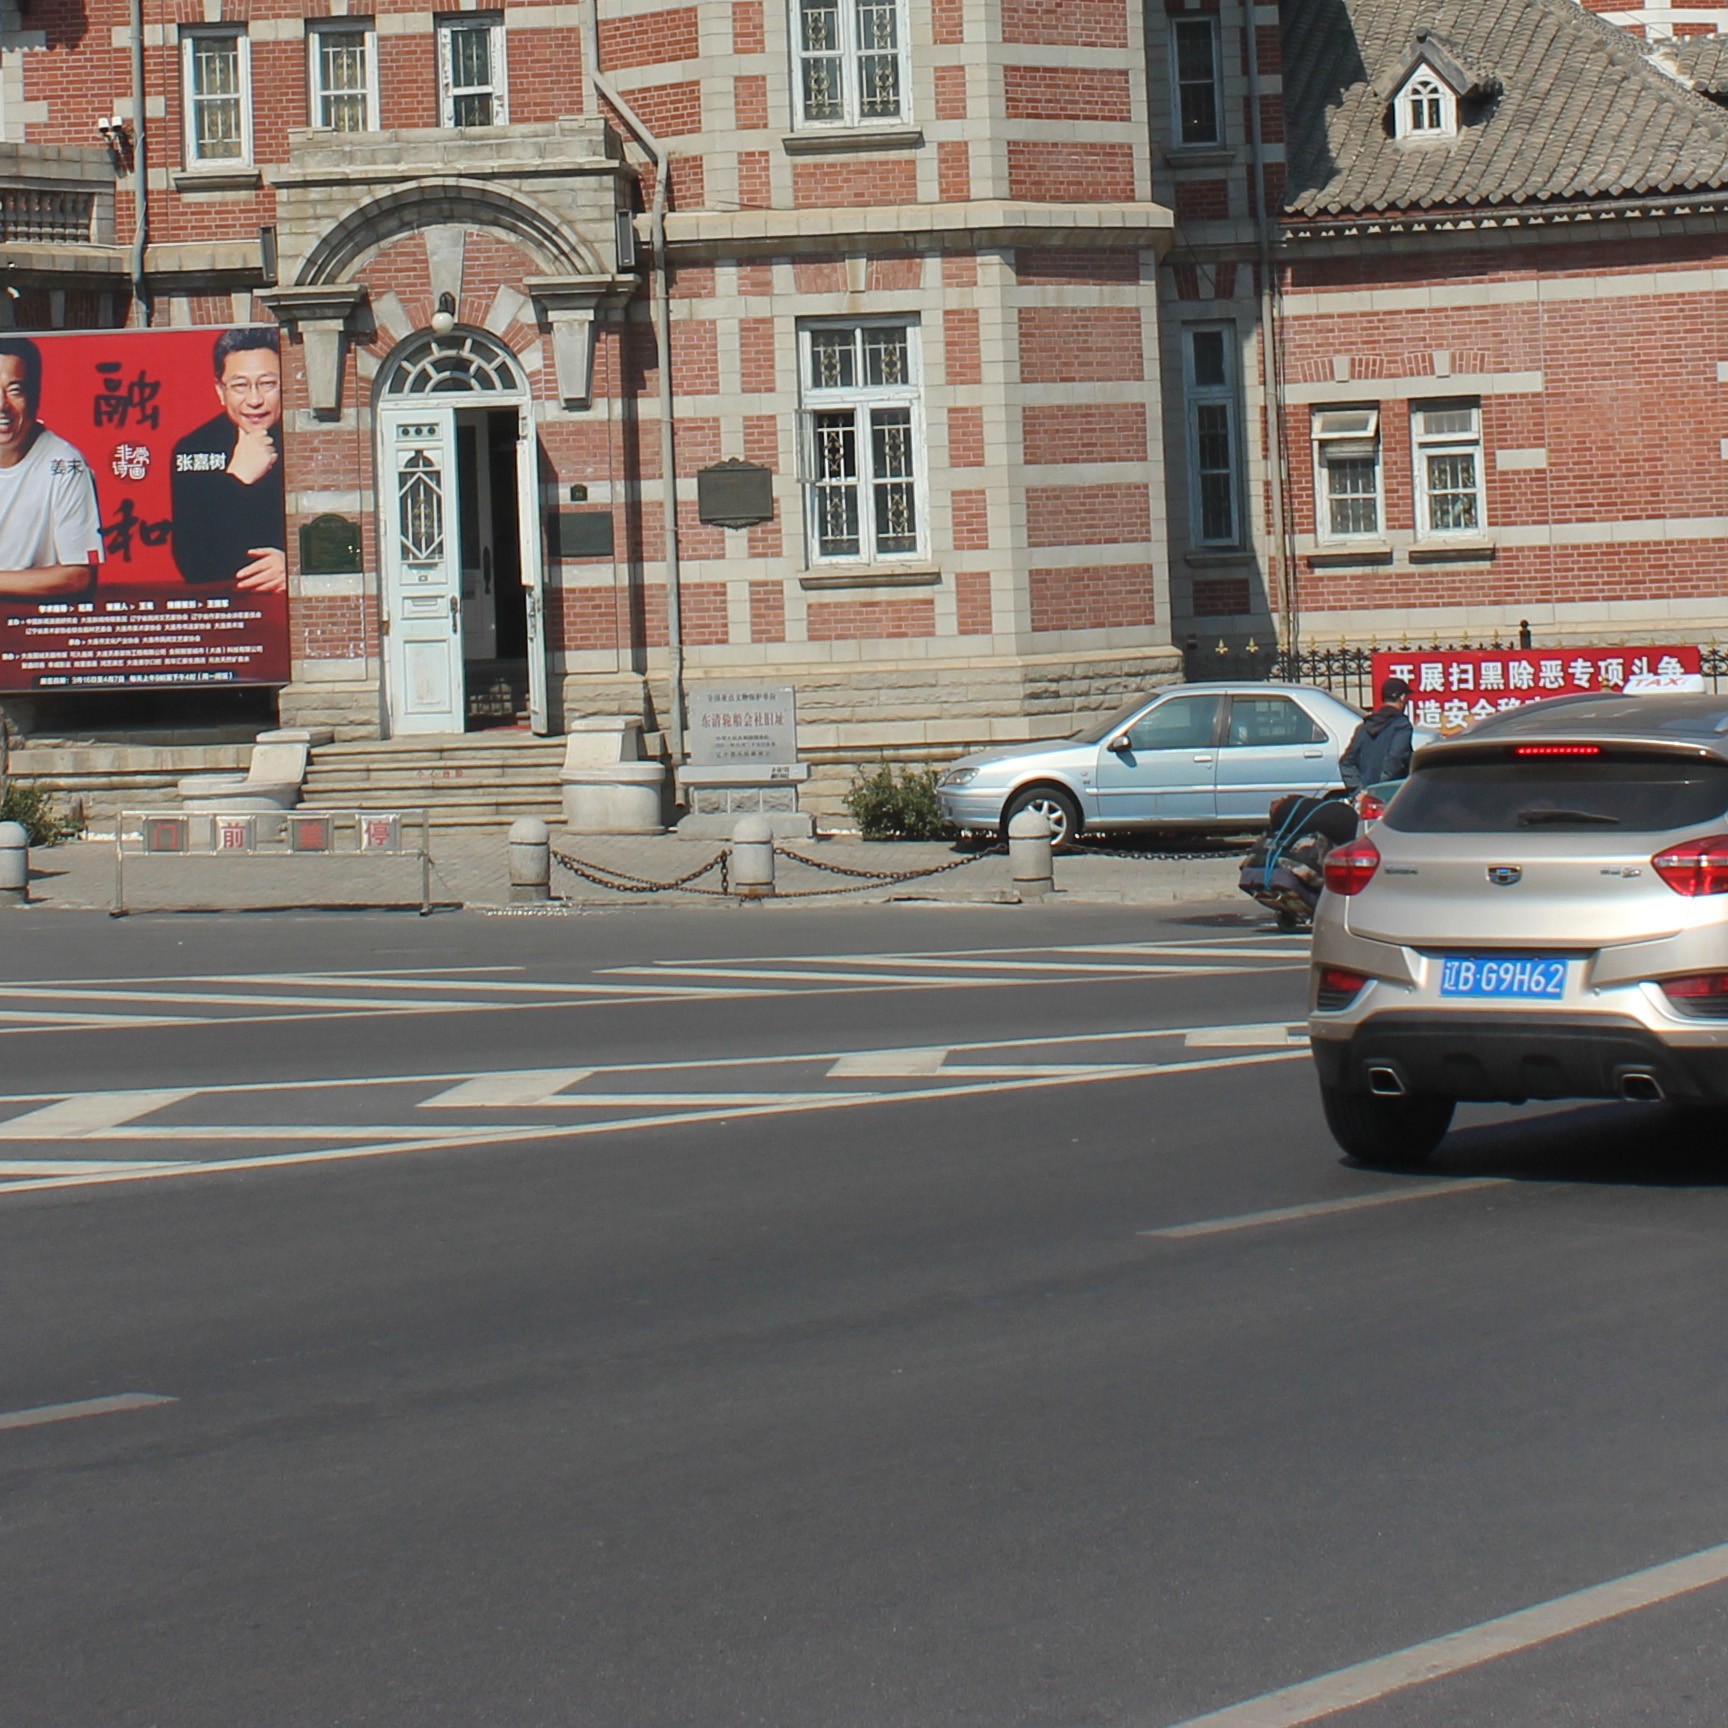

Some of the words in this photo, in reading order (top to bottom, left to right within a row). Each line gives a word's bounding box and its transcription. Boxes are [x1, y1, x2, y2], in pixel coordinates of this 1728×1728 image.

[176, 452, 226, 472] 张嘉树
[701, 712, 784, 728] 东清轮船会社旧址
